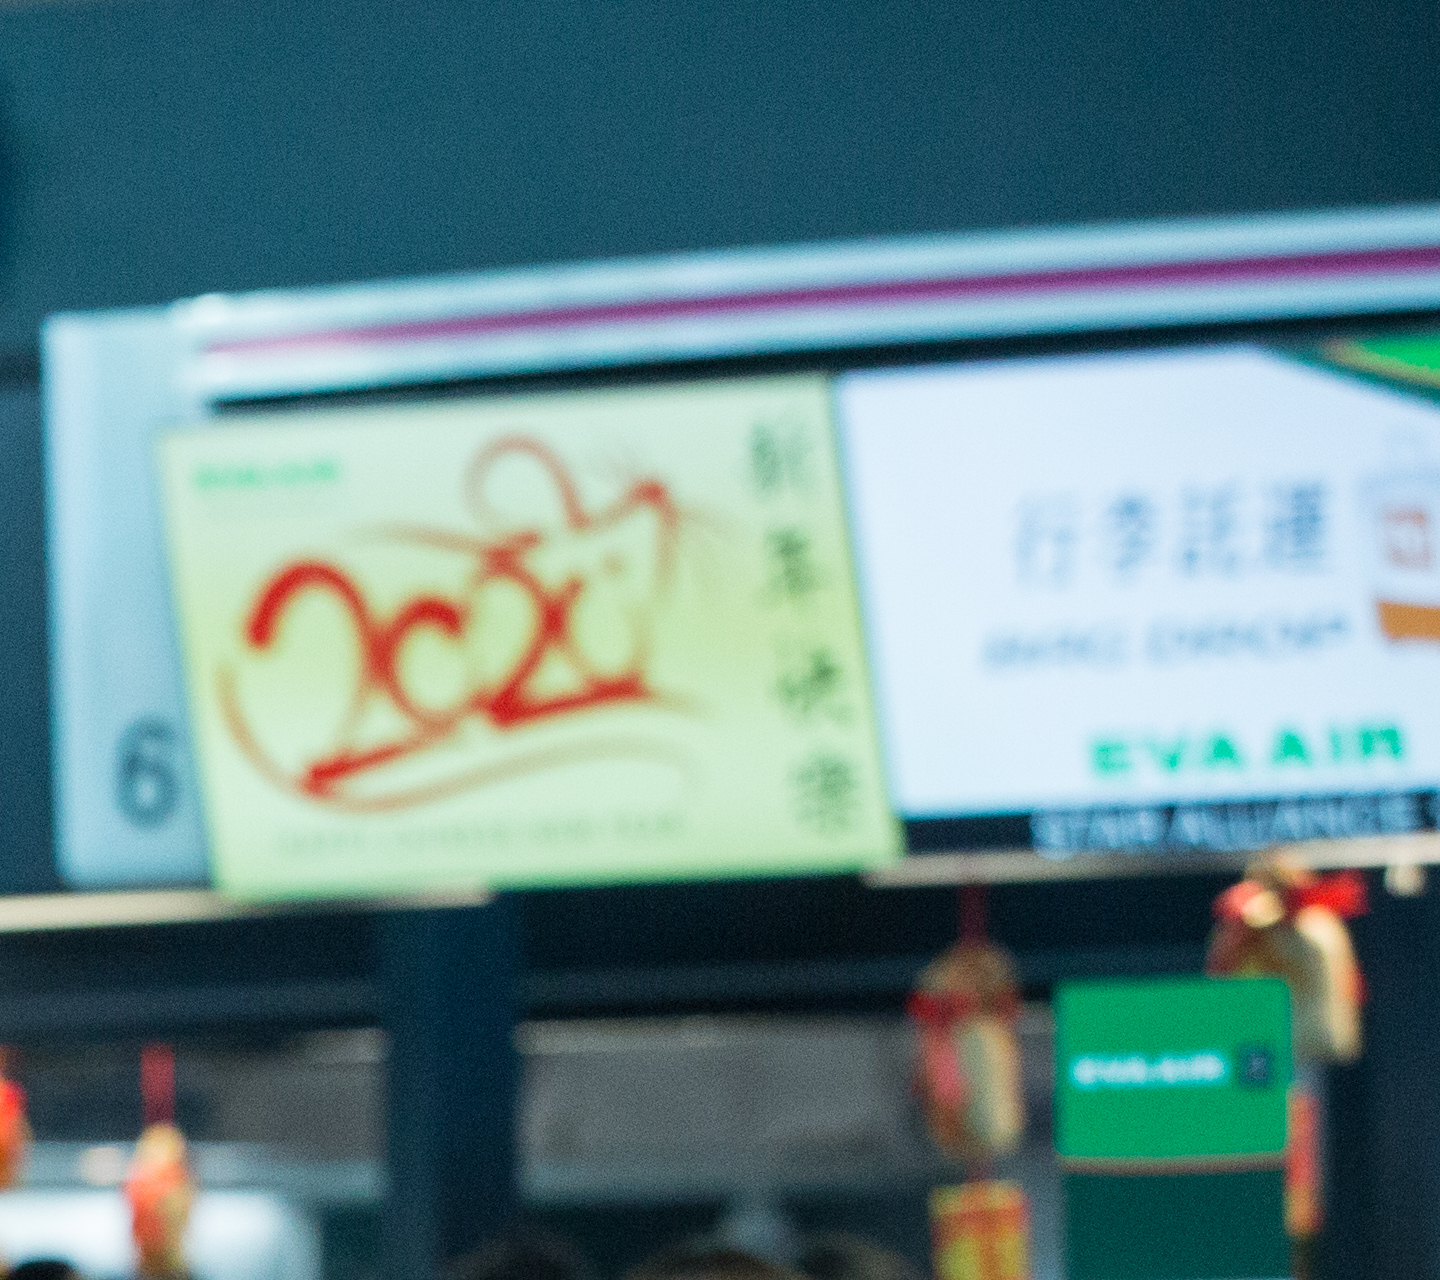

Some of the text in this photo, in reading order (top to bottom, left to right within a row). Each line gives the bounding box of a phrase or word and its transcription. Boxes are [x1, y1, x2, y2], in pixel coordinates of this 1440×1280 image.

[118, 712, 178, 830] 6
[1085, 721, 1406, 776] EVA AIR
